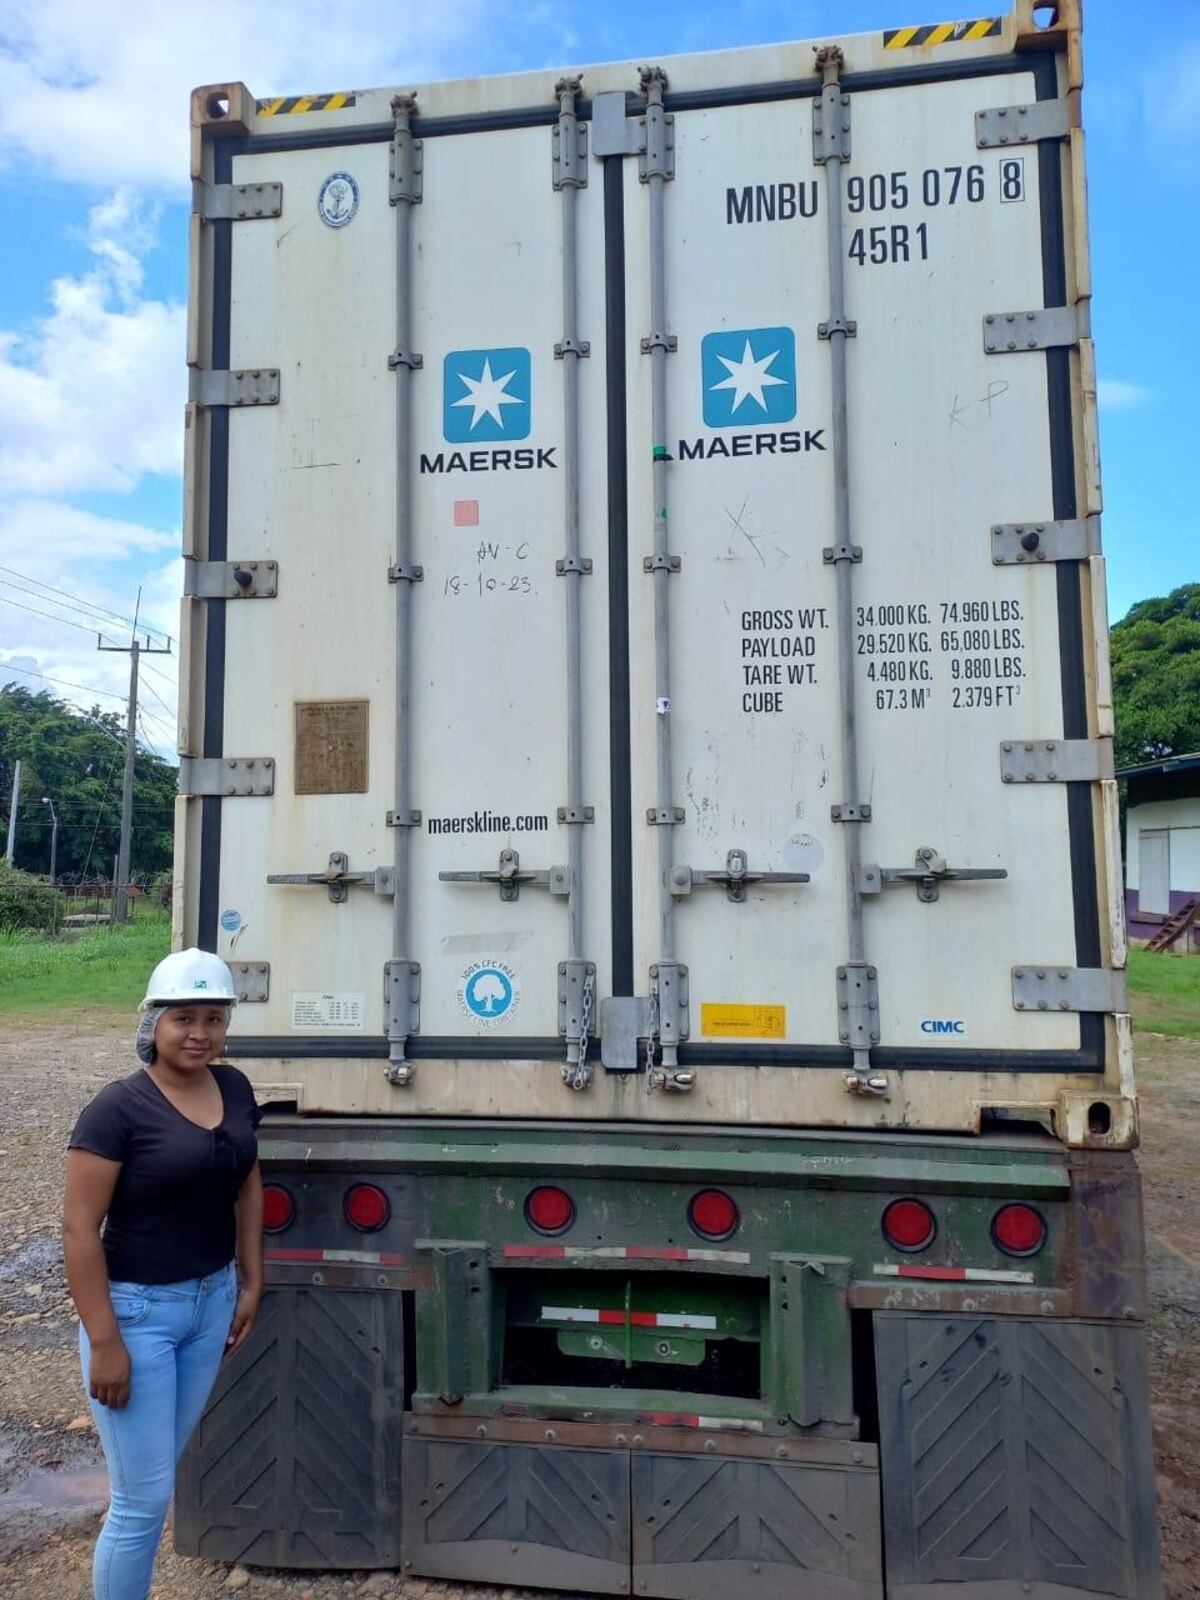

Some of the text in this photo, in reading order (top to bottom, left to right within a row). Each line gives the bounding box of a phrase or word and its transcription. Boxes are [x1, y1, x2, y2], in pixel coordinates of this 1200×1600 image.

[726, 161, 1021, 225] MNBU 905 076 8
[848, 222, 929, 266] 45R1
[678, 429, 827, 461] MAERSK
[419, 447, 558, 474] MAERSK
[741, 609, 794, 631] GROSS
[798, 608, 829, 629] WT.
[907, 603, 931, 625] KG.
[940, 600, 989, 624] 74.960
[992, 599, 1025, 622] LBS.
[741, 636, 816, 658] PAYLOAD
[908, 631, 932, 653] KG.
[993, 627, 1025, 650] LBS.
[742, 664, 782, 686] TARE
[787, 663, 818, 685] WT.
[909, 659, 934, 681] KG.
[951, 657, 991, 680] 9.880
[994, 656, 1027, 679] LBS.
[742, 691, 784, 713] CUBE
[876, 688, 907, 711] 67.3
[952, 685, 992, 708] 2.379
[427, 810, 548, 835] maerskline.com
[920, 1020, 965, 1033] CIMC
